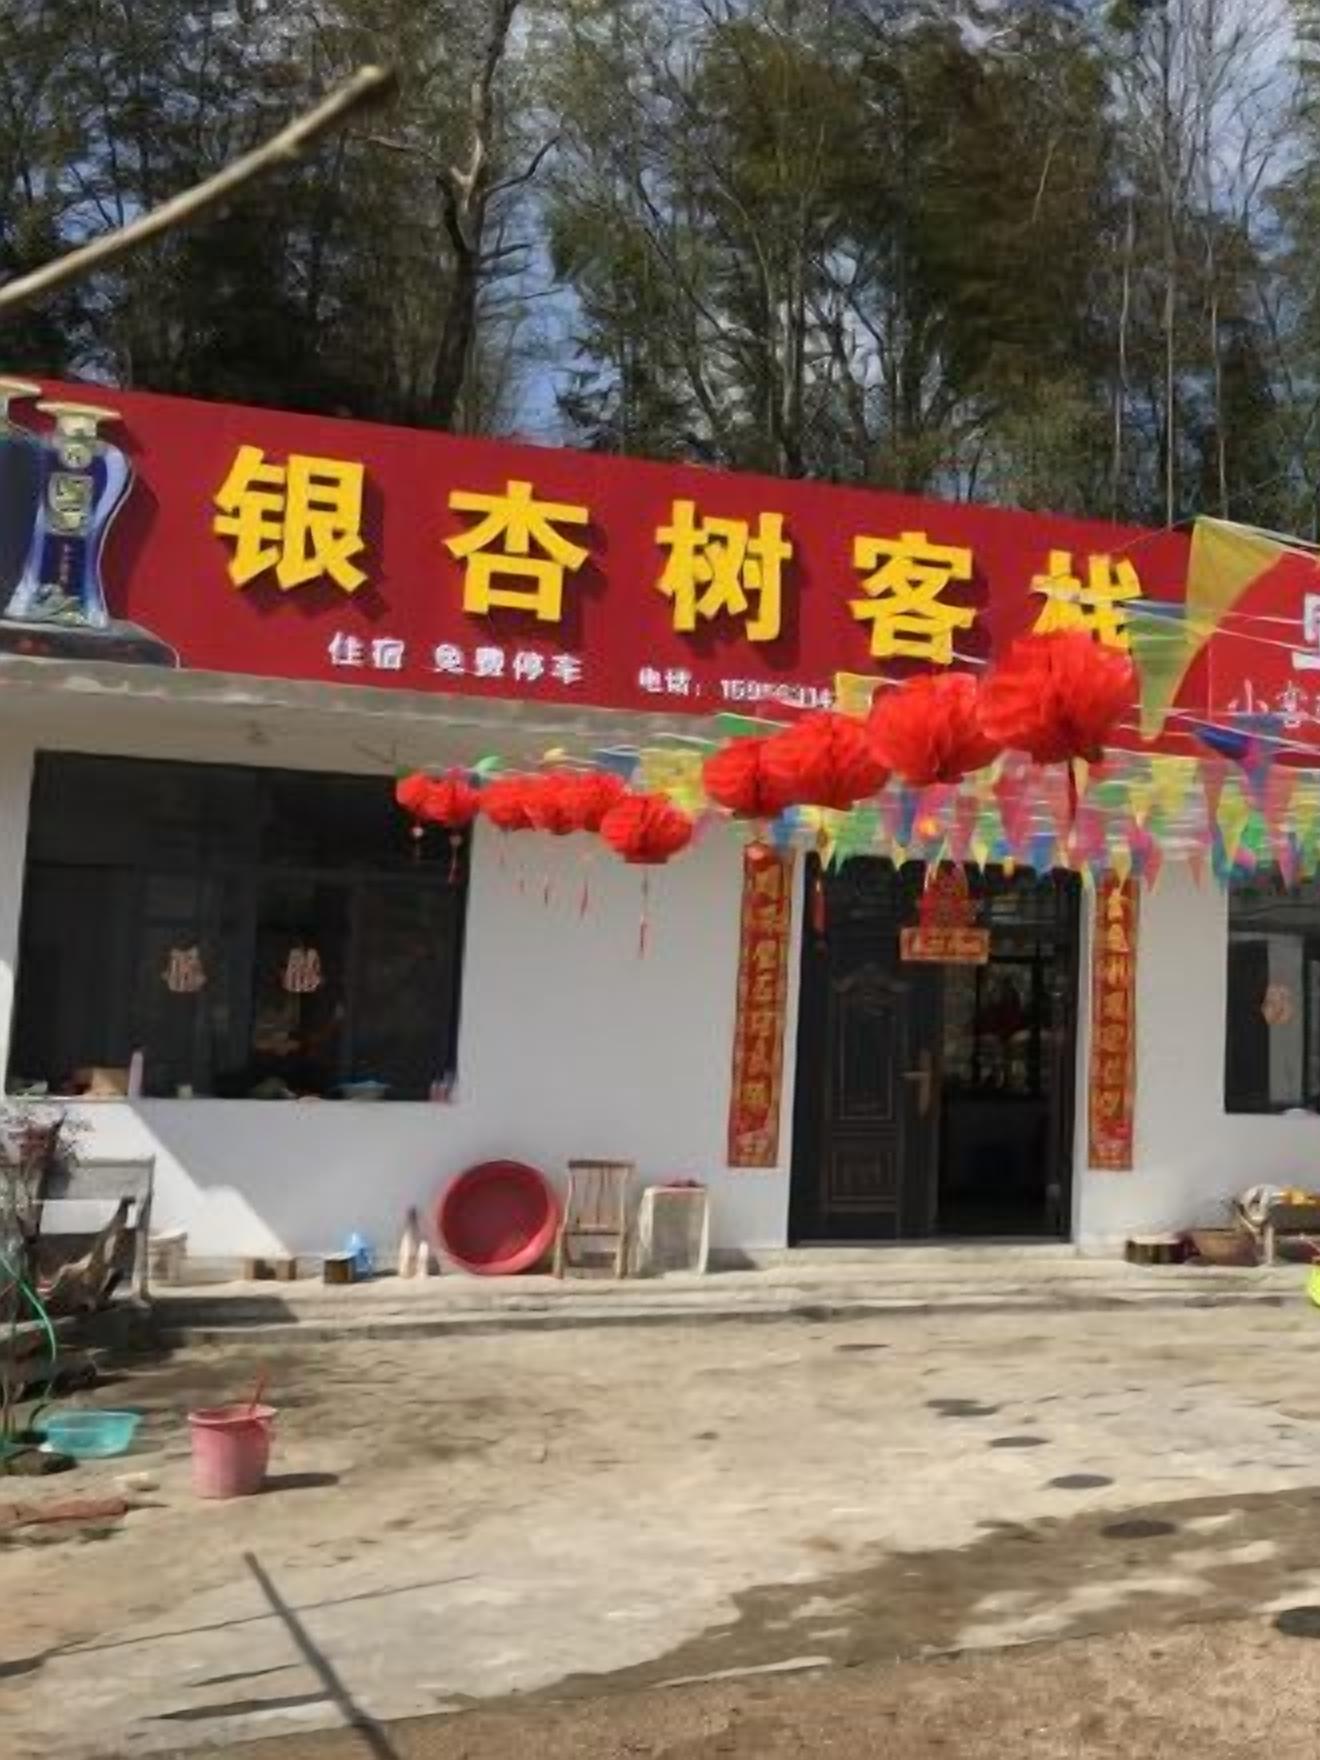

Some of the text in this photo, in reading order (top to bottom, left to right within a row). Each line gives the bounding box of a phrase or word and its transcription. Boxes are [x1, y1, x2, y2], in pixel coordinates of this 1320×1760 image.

[212, 444, 1143, 664] 银杏树客栈
[328, 631, 406, 670] 住宿
